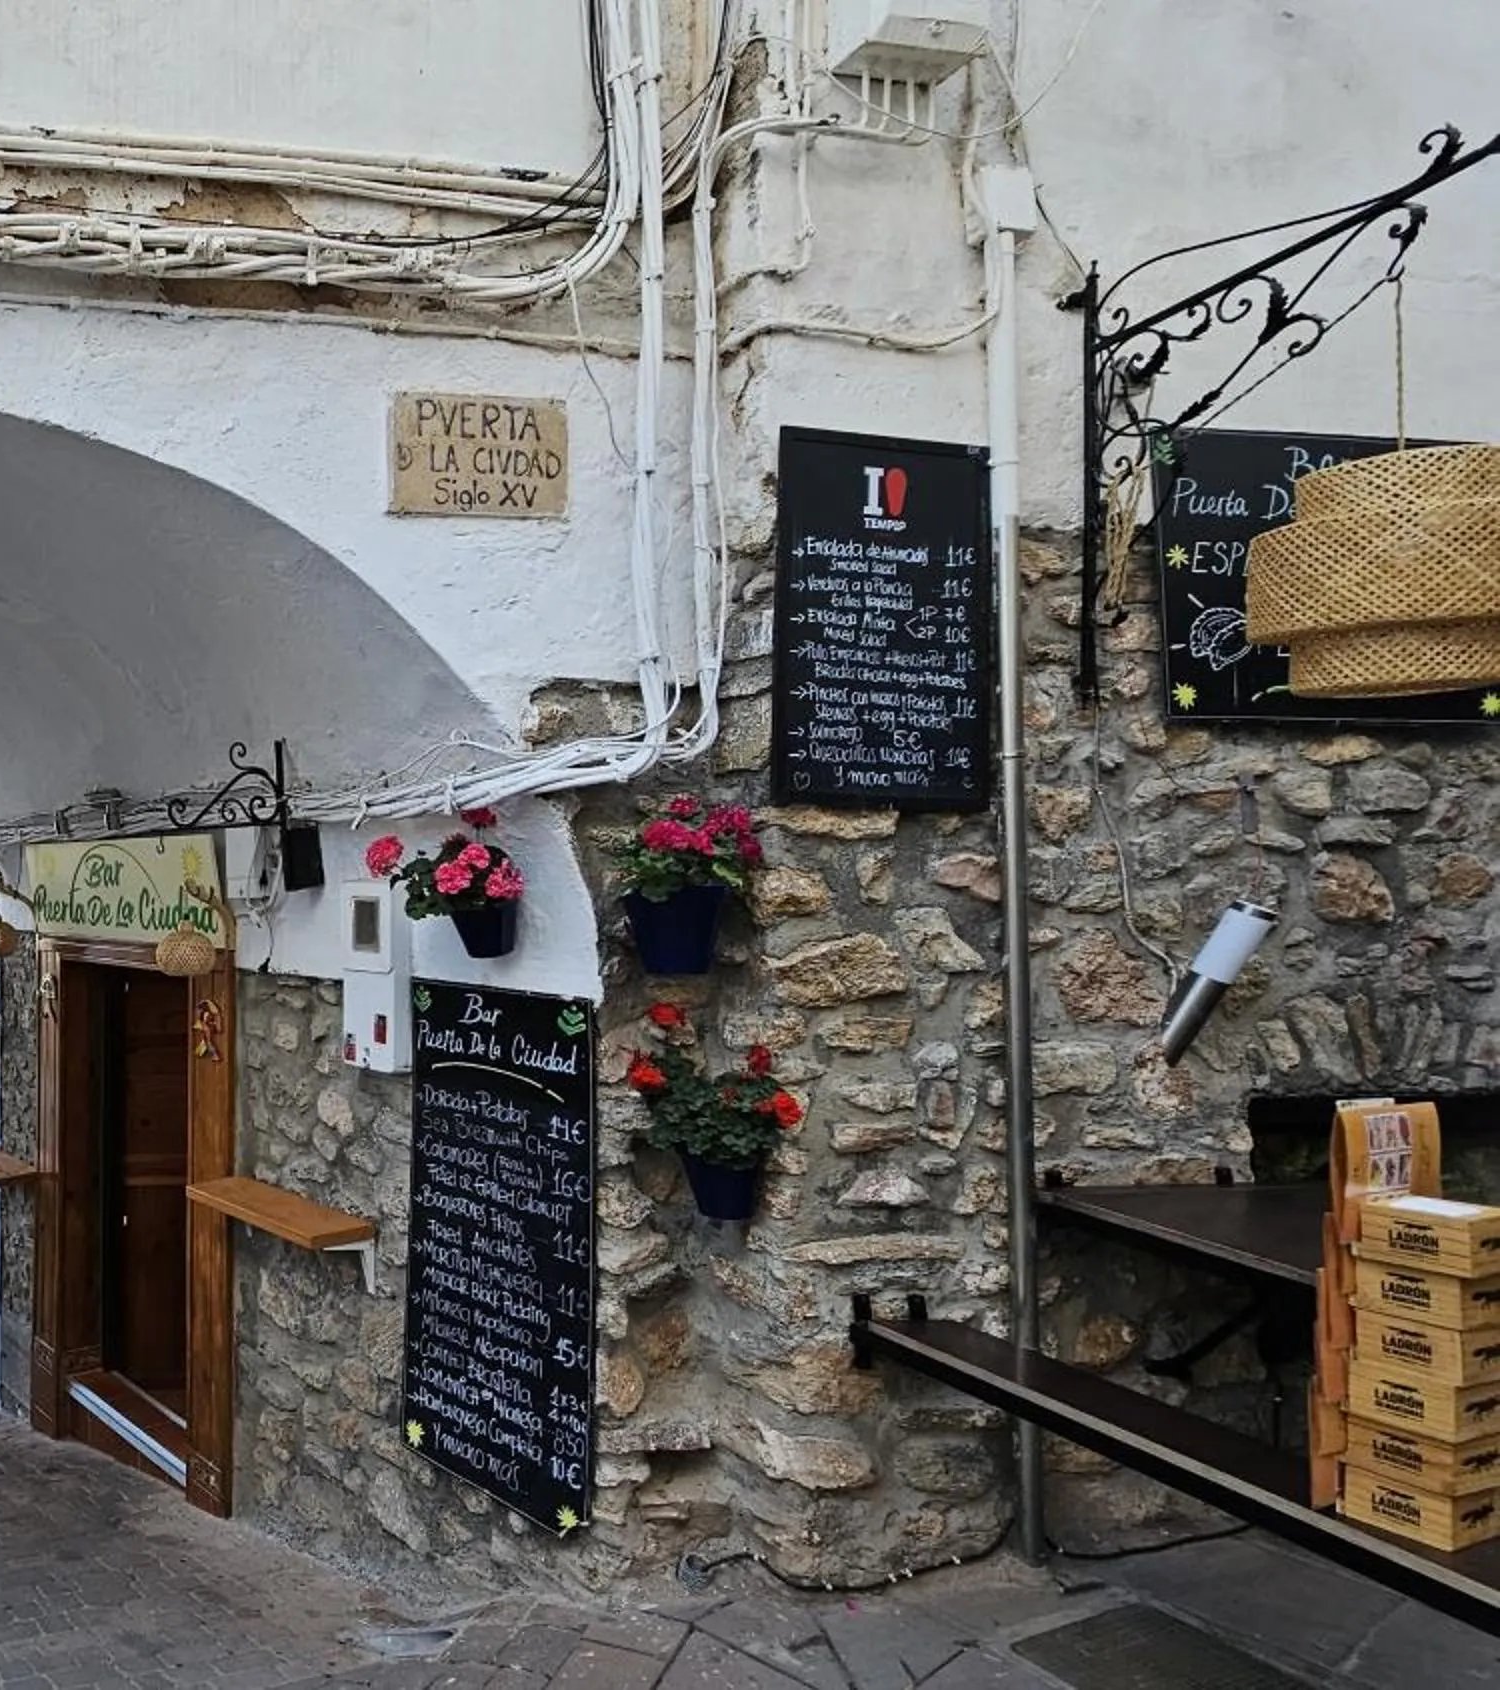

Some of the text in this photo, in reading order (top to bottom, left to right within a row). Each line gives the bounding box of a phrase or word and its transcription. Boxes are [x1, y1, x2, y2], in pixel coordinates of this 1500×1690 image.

[429, 443, 460, 473] LA
[1284, 446, 1334, 483] Ba
[433, 477, 538, 511] Siglo XV
[1172, 477, 1248, 517] Puerta
[1192, 542, 1249, 576] ESP
[84, 854, 124, 888] Bar
[34, 884, 86, 925] Puerta
[87, 896, 114, 926] De
[139, 885, 218, 934] Ciudad
[458, 993, 503, 1027] Bar
[417, 1019, 465, 1054] Puerta
[511, 1033, 577, 1075] Ciudad
[525, 1134, 570, 1167] Chips
